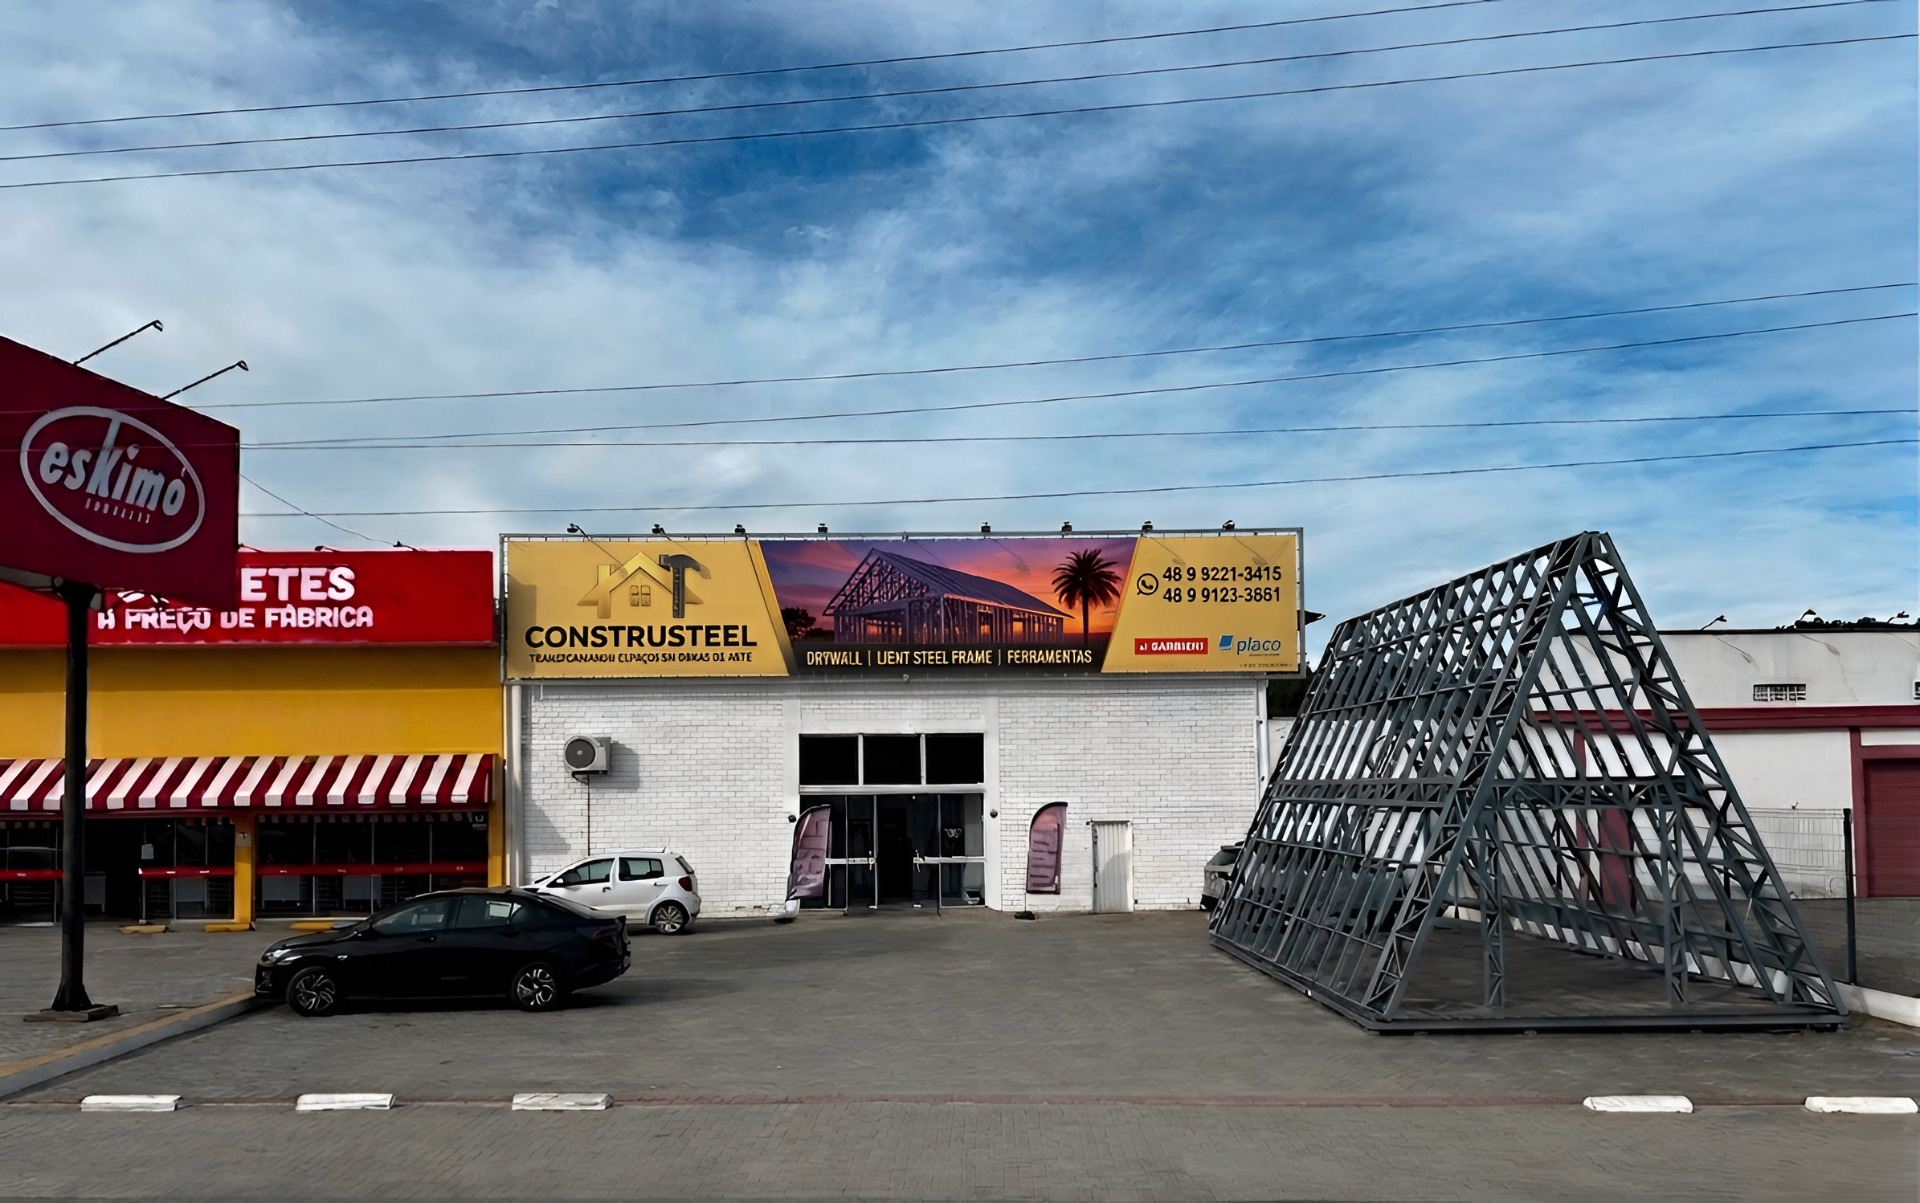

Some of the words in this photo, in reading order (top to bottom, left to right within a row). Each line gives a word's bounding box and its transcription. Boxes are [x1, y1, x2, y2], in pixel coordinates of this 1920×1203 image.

[39, 419, 187, 516] eskimo
[1163, 567, 1183, 581] 48
[1187, 567, 1197, 581] 9
[1163, 588, 1183, 603] 48
[1187, 587, 1197, 602] 9
[524, 625, 757, 648] CONSTRUSTEEL
[1237, 637, 1281, 655] placo
[806, 651, 863, 666] DRYWALL
[913, 651, 949, 665] STEEL
[952, 650, 993, 664] FRAME
[1007, 650, 1092, 664] FERRAMENTAS
